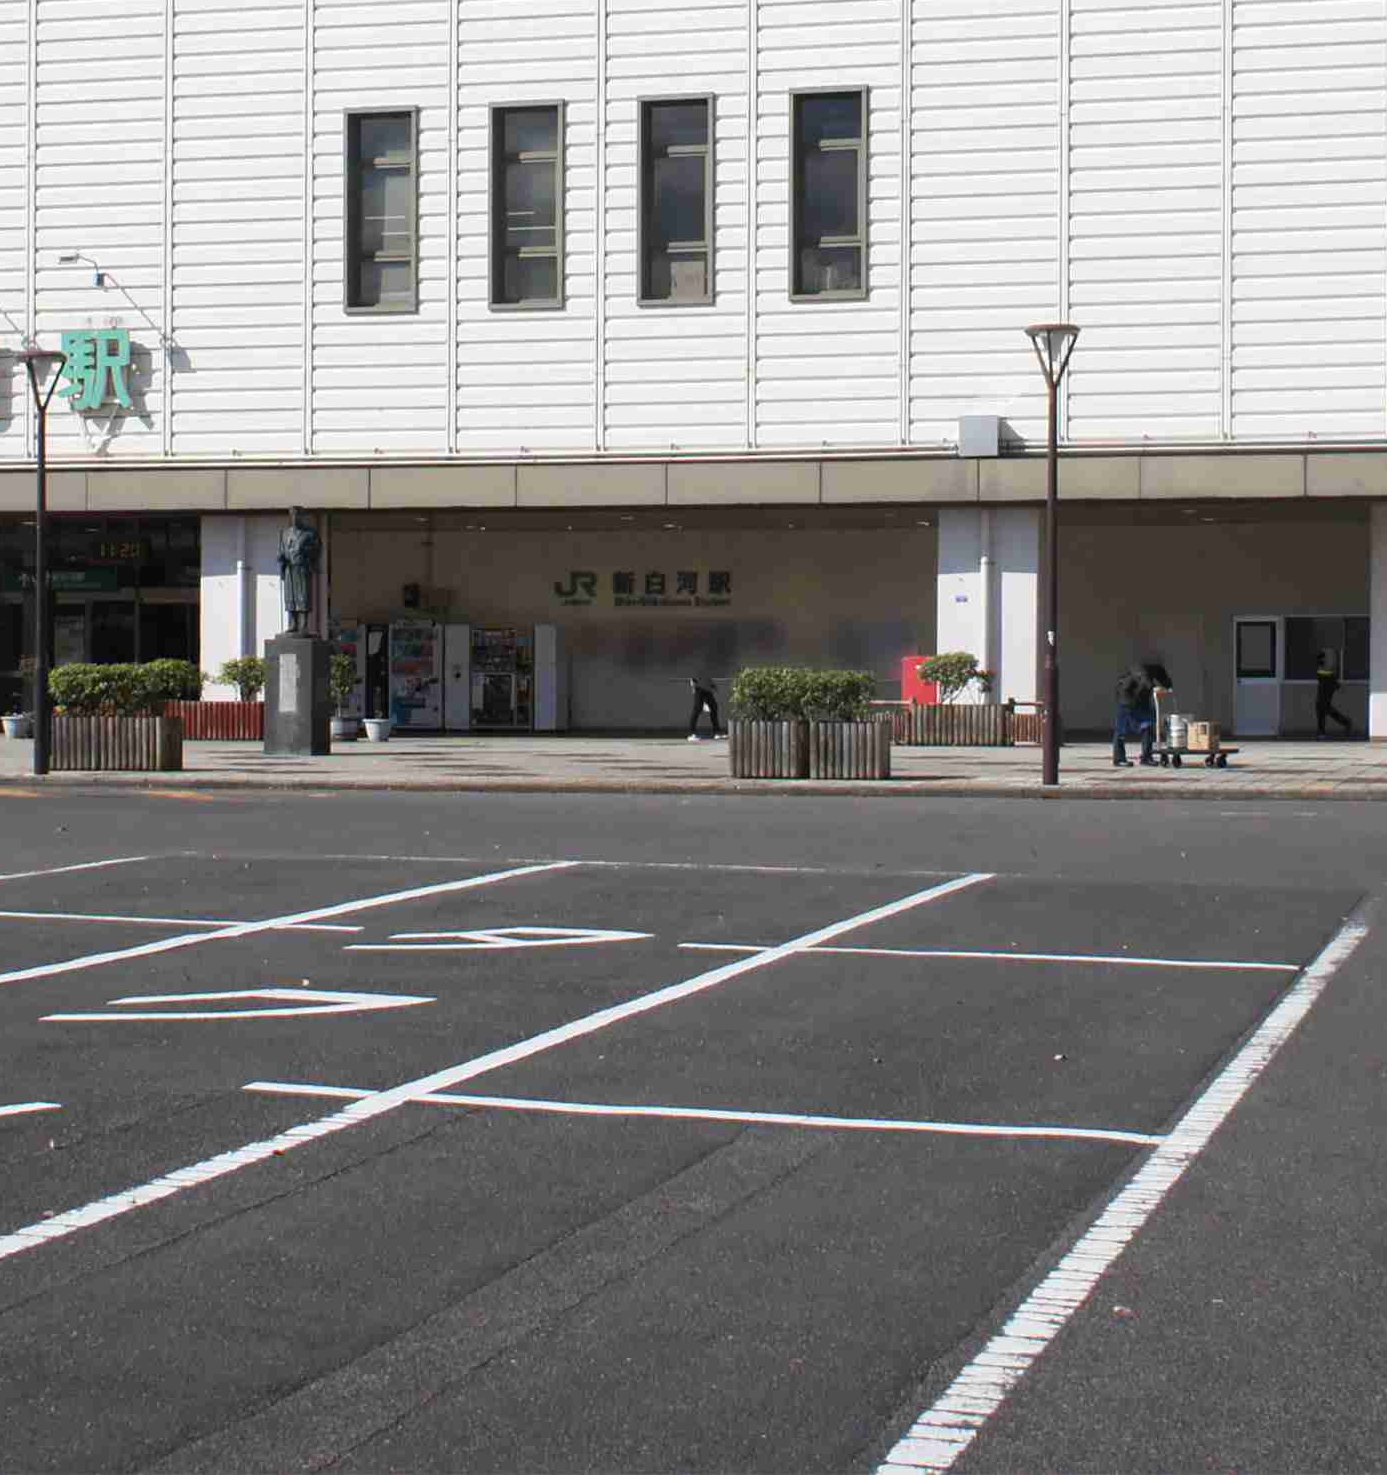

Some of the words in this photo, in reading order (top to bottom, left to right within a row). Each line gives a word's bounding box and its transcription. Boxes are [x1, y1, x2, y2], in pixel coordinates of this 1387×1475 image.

[553, 571, 597, 597] JR
[613, 571, 732, 594] 新白河駅
